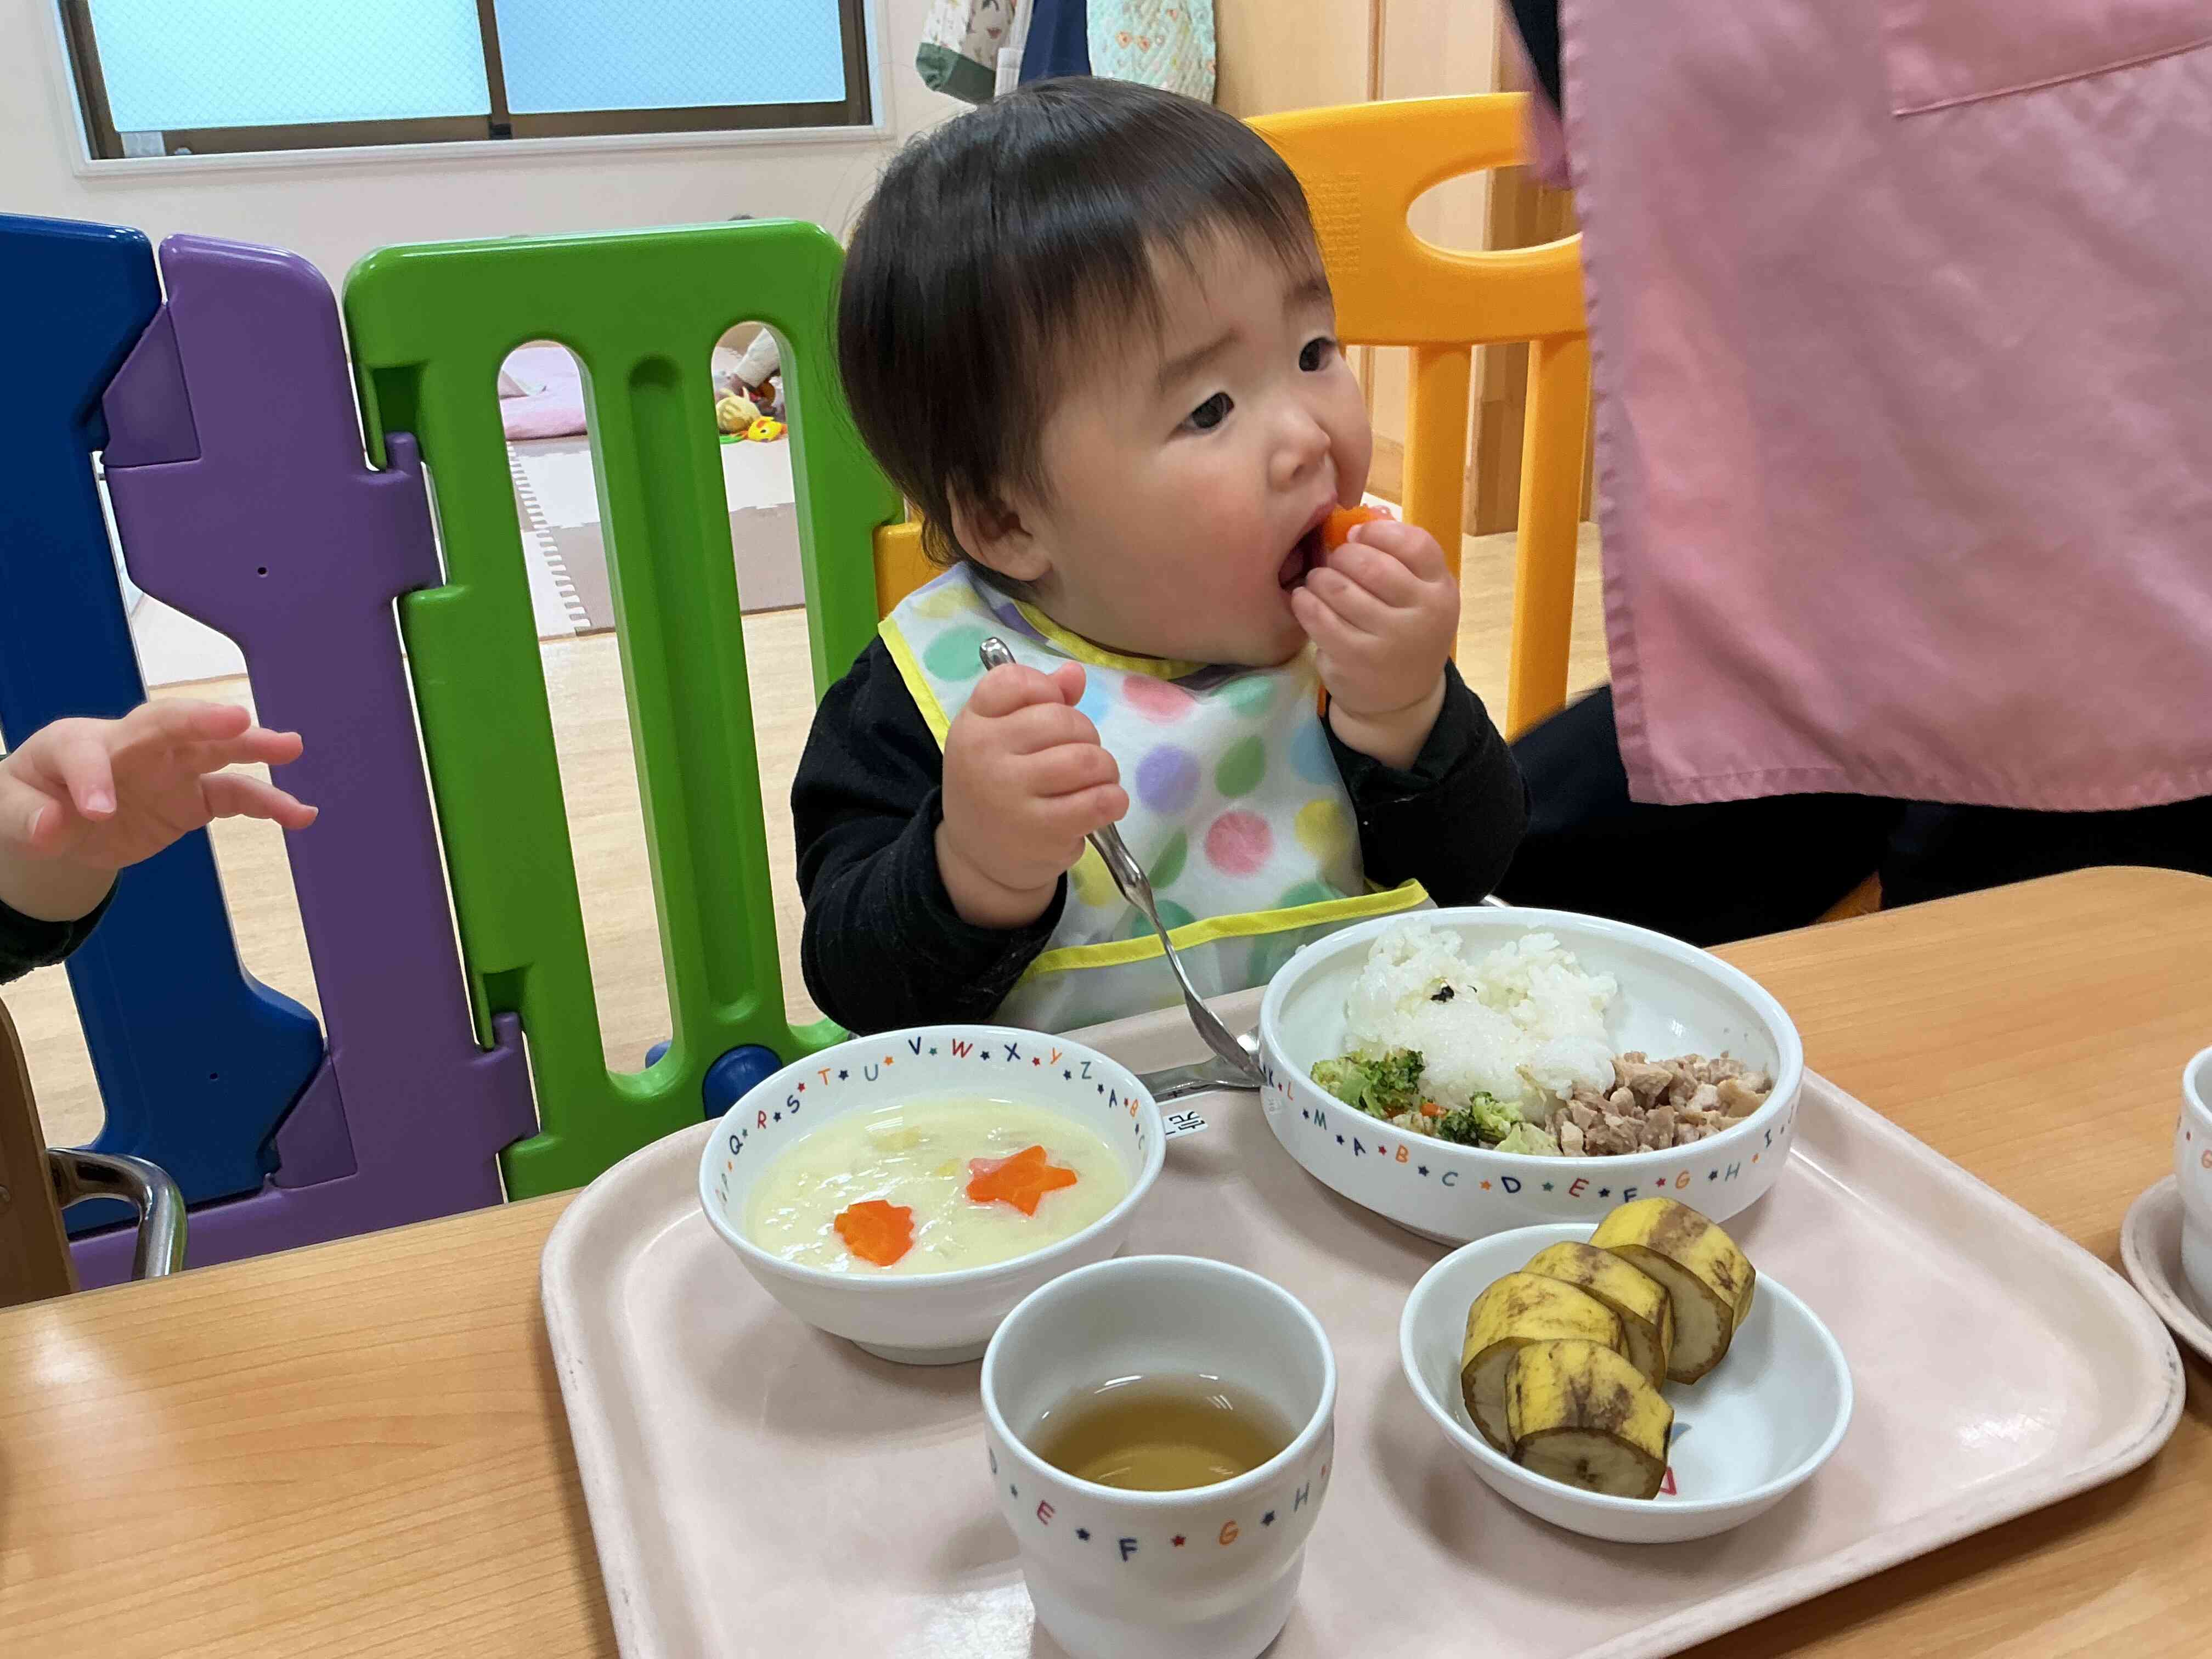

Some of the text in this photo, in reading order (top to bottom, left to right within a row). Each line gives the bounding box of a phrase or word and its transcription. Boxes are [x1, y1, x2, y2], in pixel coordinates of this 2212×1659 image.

[730, 1135, 743, 1155] Q
[758, 1110, 766, 1128] R
[787, 1095, 800, 1113] S
[818, 1068, 831, 1085] T
[865, 1064, 878, 1081] U
[909, 1037, 921, 1055] V
[952, 1039, 973, 1058] W
[1005, 1043, 1020, 1062] X
[1051, 1048, 1062, 1064] Y
[1081, 1062, 1092, 1079] Z
[1109, 1089, 1117, 1108] A
[1314, 1109, 1327, 1130] M
[1354, 1138, 1365, 1156] A
[1396, 1144, 1409, 1163] B
[1442, 1171, 1458, 1186] C
[1501, 1176, 1521, 1193] D
[1568, 1178, 1589, 1197] E
[1624, 1188, 1637, 1203] F
[1675, 1170, 1690, 1189] G
[1725, 1162, 1741, 1181] H
[1037, 1500, 1054, 1525] E
[1119, 1538, 1137, 1562] F
[1219, 1520, 1239, 1545] G
[1294, 1482, 1309, 1513] H
